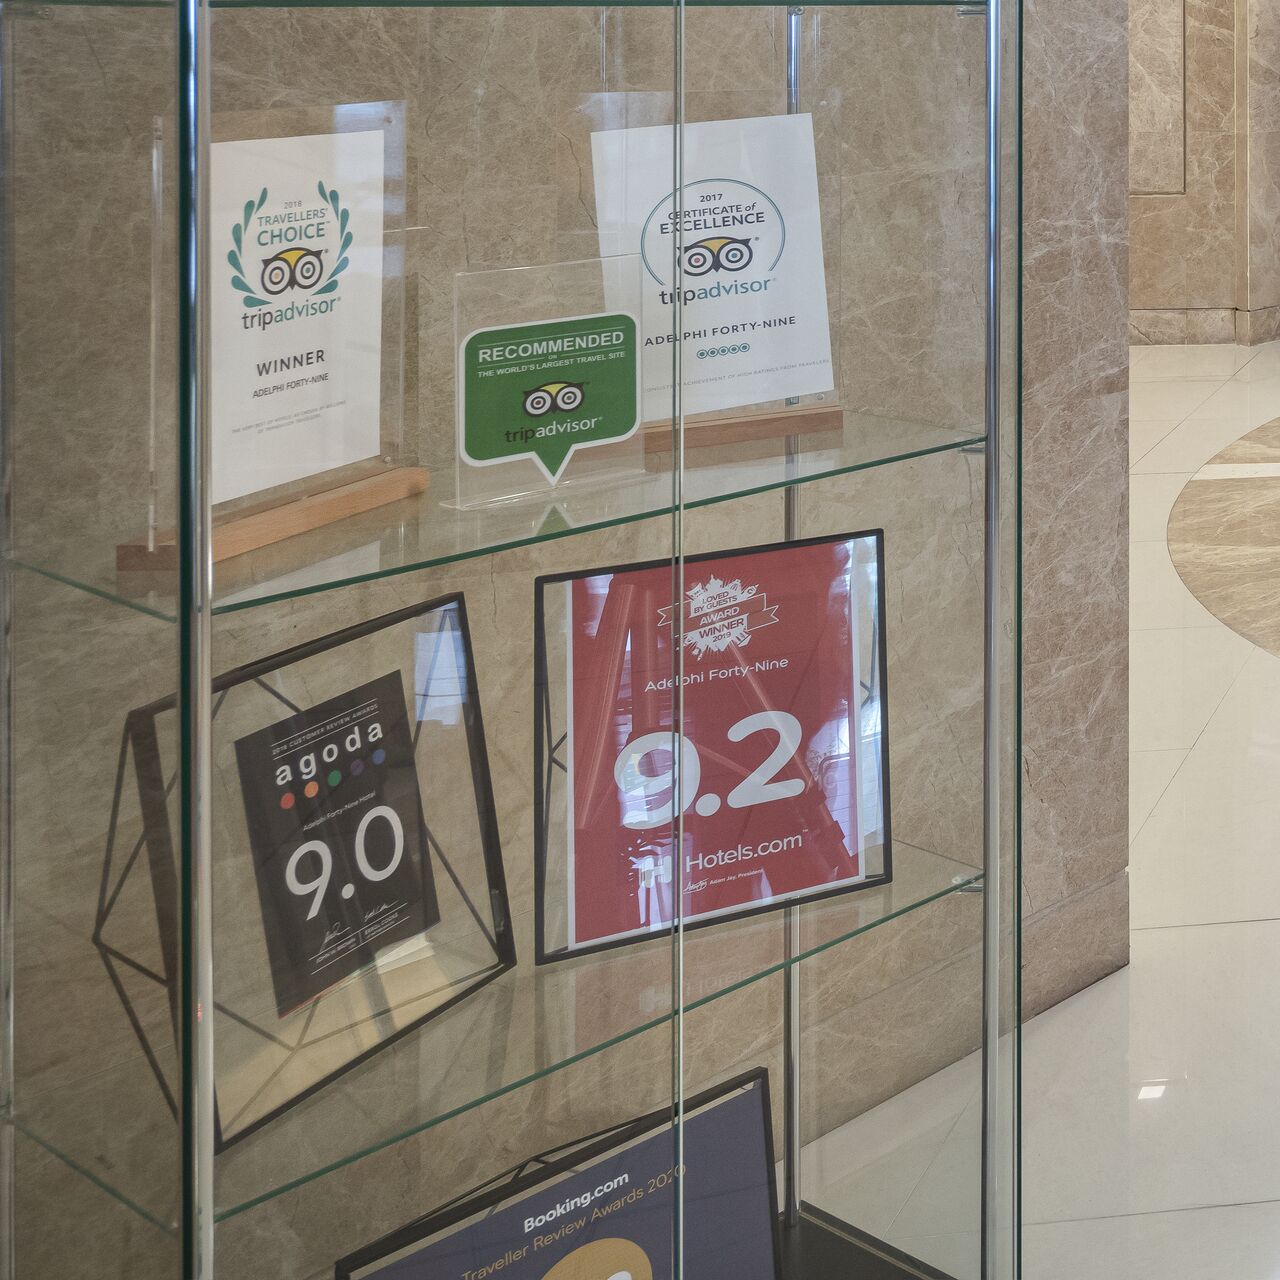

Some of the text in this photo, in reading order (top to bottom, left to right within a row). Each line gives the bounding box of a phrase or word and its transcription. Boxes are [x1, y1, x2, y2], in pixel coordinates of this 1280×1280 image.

[284, 200, 302, 209] 2018
[700, 193, 723, 203] 2017
[660, 212, 765, 235] EXCELLENCE
[668, 202, 757, 220] CERTIFICATE of
[257, 222, 325, 247] CHOICE
[659, 280, 771, 306] tripadvisor
[242, 297, 337, 331] tripadvisor
[712, 316, 797, 337] FORTY-NINE
[478, 331, 625, 363] RECOMMENDED
[256, 349, 325, 377] WINNER
[477, 351, 626, 378] THE WORLD'S LARGEST TRAVEL SITE
[252, 372, 329, 399] ADELPHI FORTY-NINE
[505, 418, 598, 443] tripadvisor
[694, 595, 738, 614] BY GUESTS
[702, 591, 729, 604] LOVED
[699, 618, 745, 639] WINNER
[700, 607, 740, 625] AWARD
[712, 631, 732, 642] 2019
[644, 657, 789, 692] Adelphi Forty-Nine
[326, 716, 351, 730] REVIEW
[275, 722, 383, 785] agoda
[614, 710, 806, 830] 9.2
[285, 805, 404, 921] 9.0
[685, 833, 802, 872] Hotels.com
[523, 1173, 629, 1233] Booking.com
[461, 1245, 529, 1280] Traveller
[533, 1216, 586, 1251] Review
[591, 1187, 644, 1222] Awards
